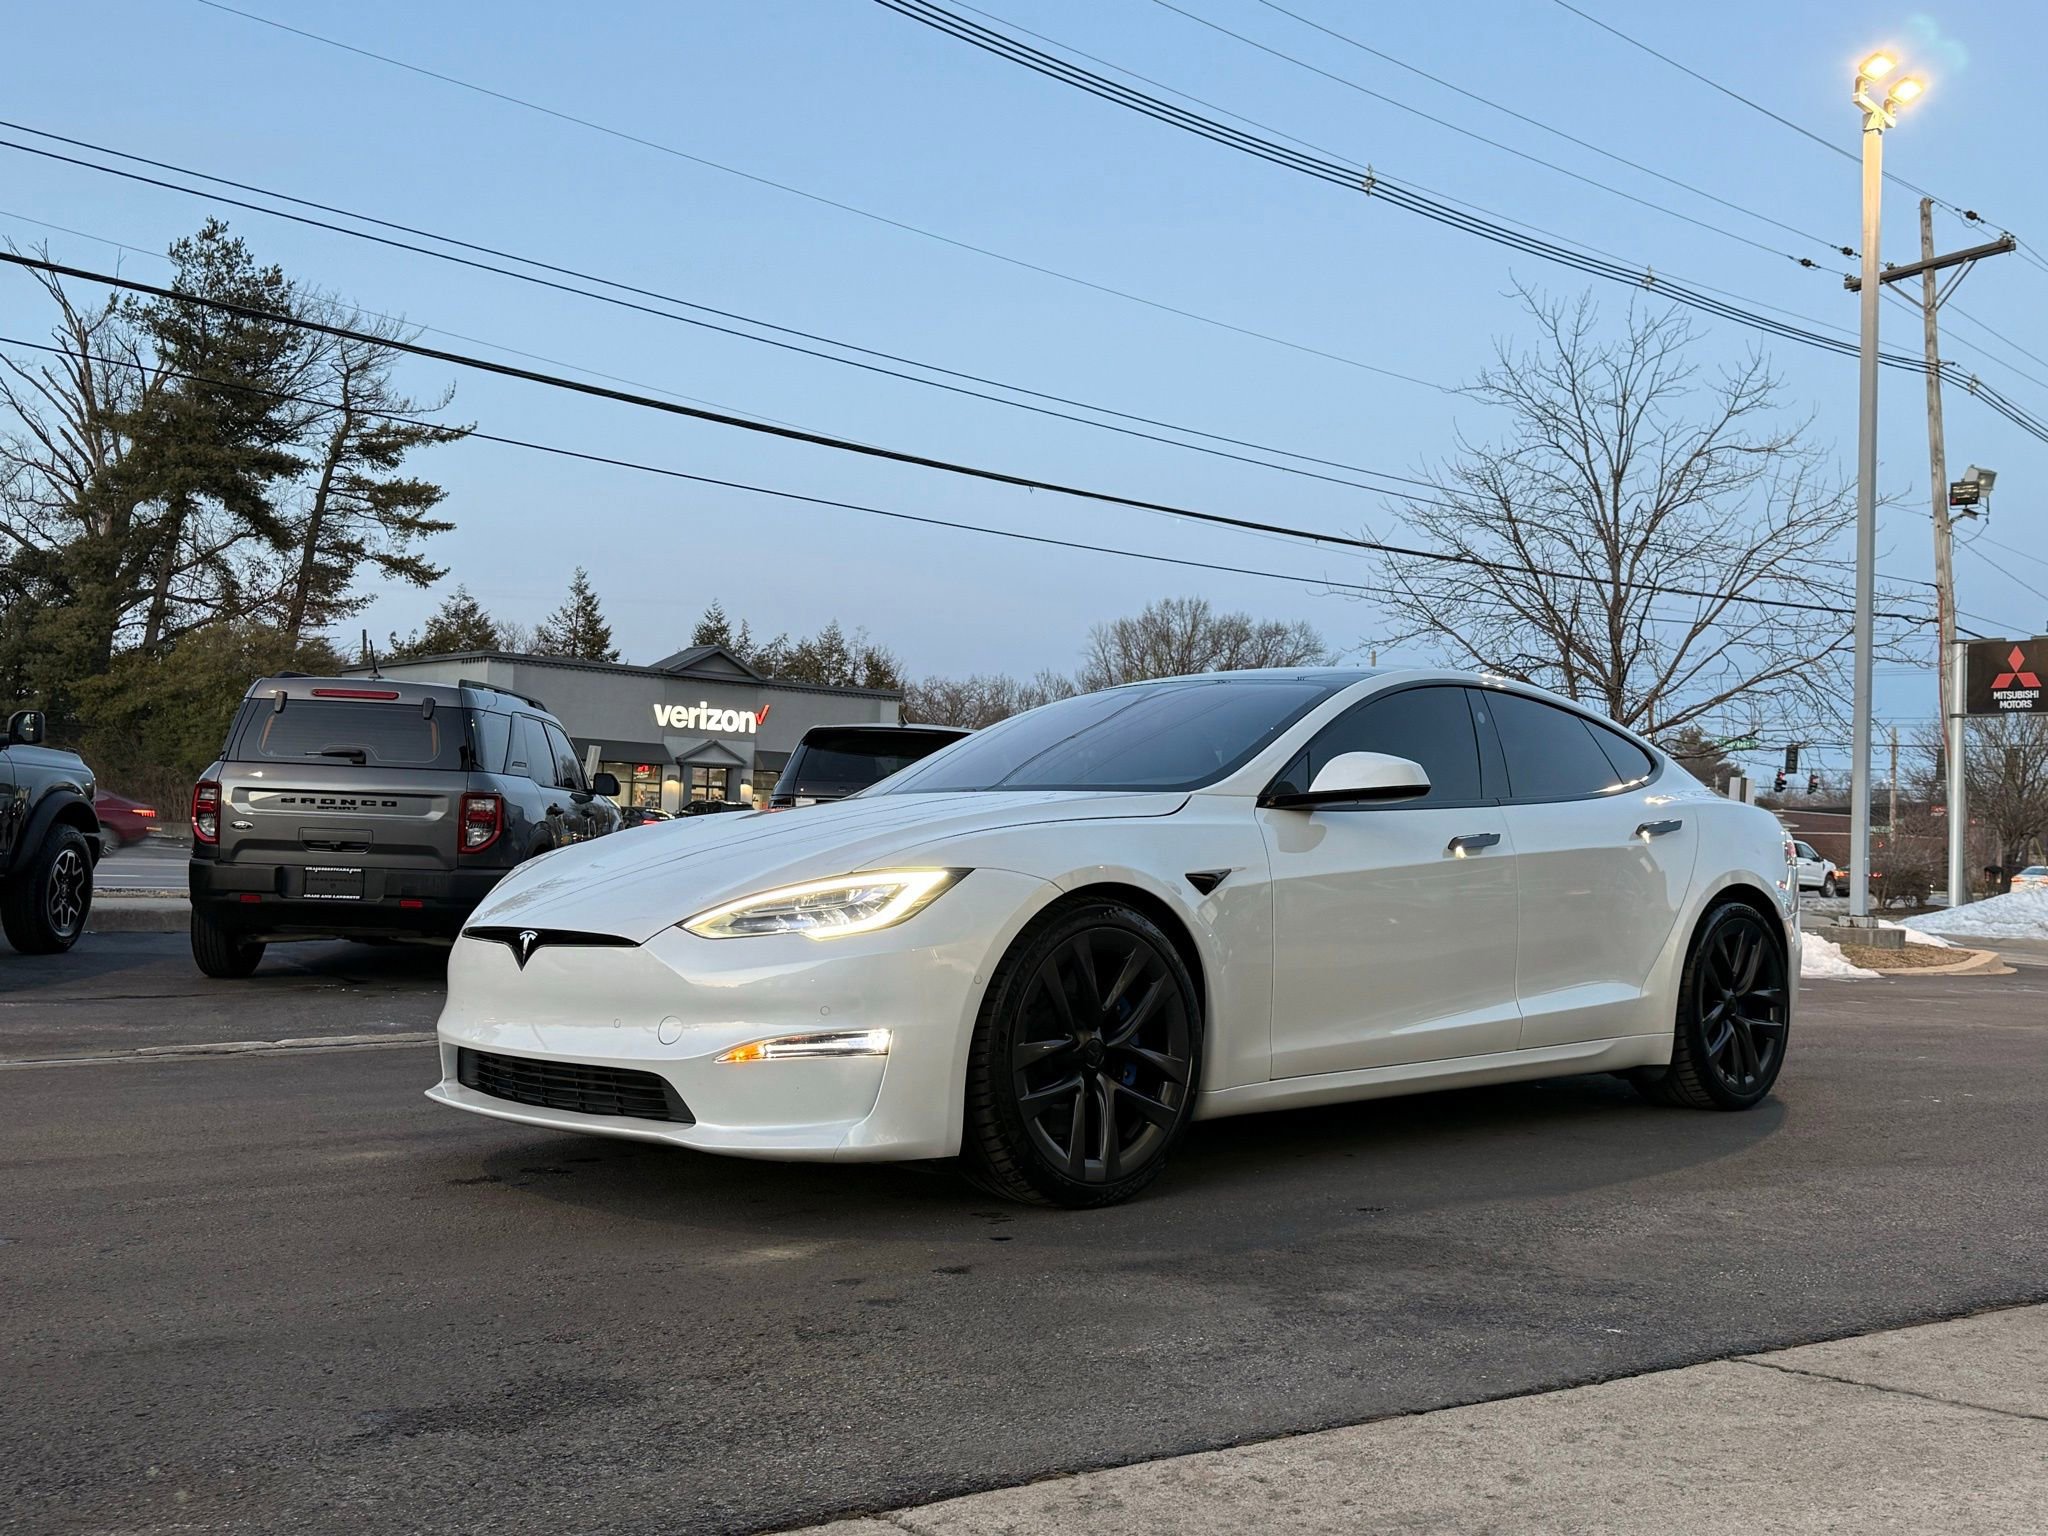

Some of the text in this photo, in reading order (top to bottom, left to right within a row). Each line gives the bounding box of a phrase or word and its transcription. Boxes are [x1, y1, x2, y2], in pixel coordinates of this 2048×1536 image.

[1993, 690, 2039, 699] MITSUBISHI
[2000, 700, 2032, 709] MOTORS
[653, 701, 757, 733] verizon
[280, 797, 397, 807] BRONCO
